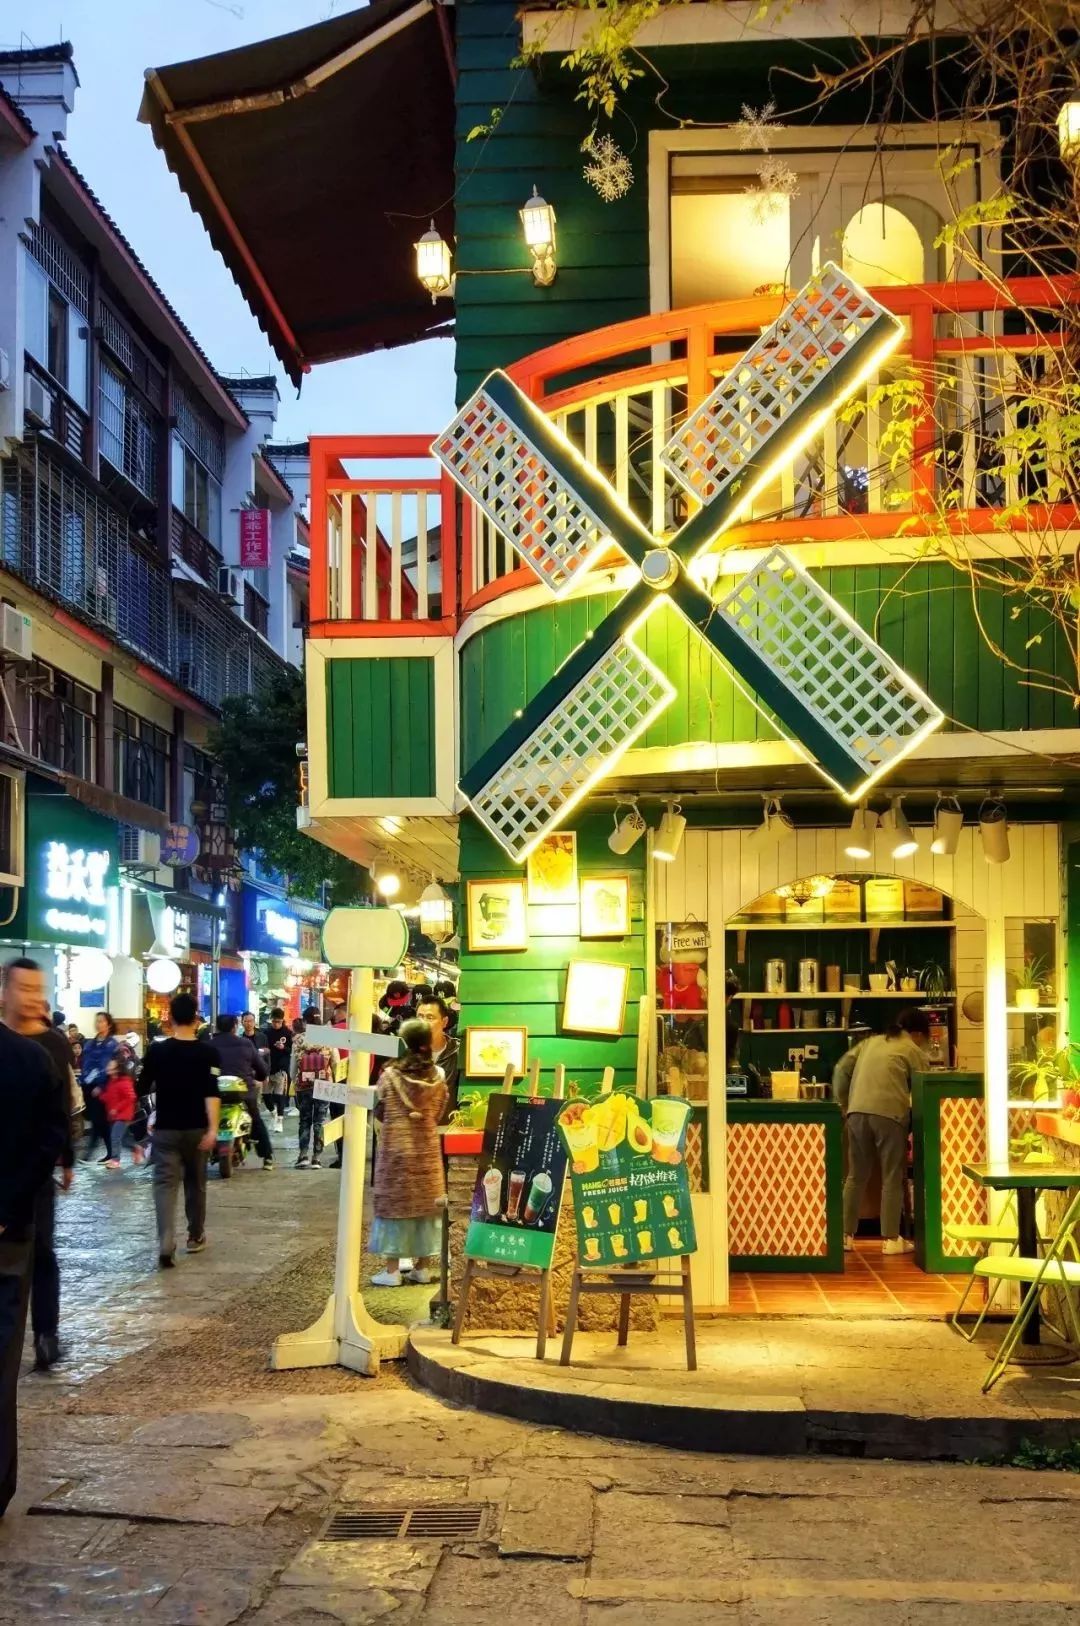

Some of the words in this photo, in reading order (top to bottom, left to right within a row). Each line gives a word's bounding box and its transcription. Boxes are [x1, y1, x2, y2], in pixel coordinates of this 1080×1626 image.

[244, 511, 262, 561] 乖乖工作室
[673, 937, 690, 948] Free
[630, 1170, 678, 1187] 招牌推荐
[583, 1188, 606, 1197] FRESH
[608, 1185, 629, 1194] JUICE
